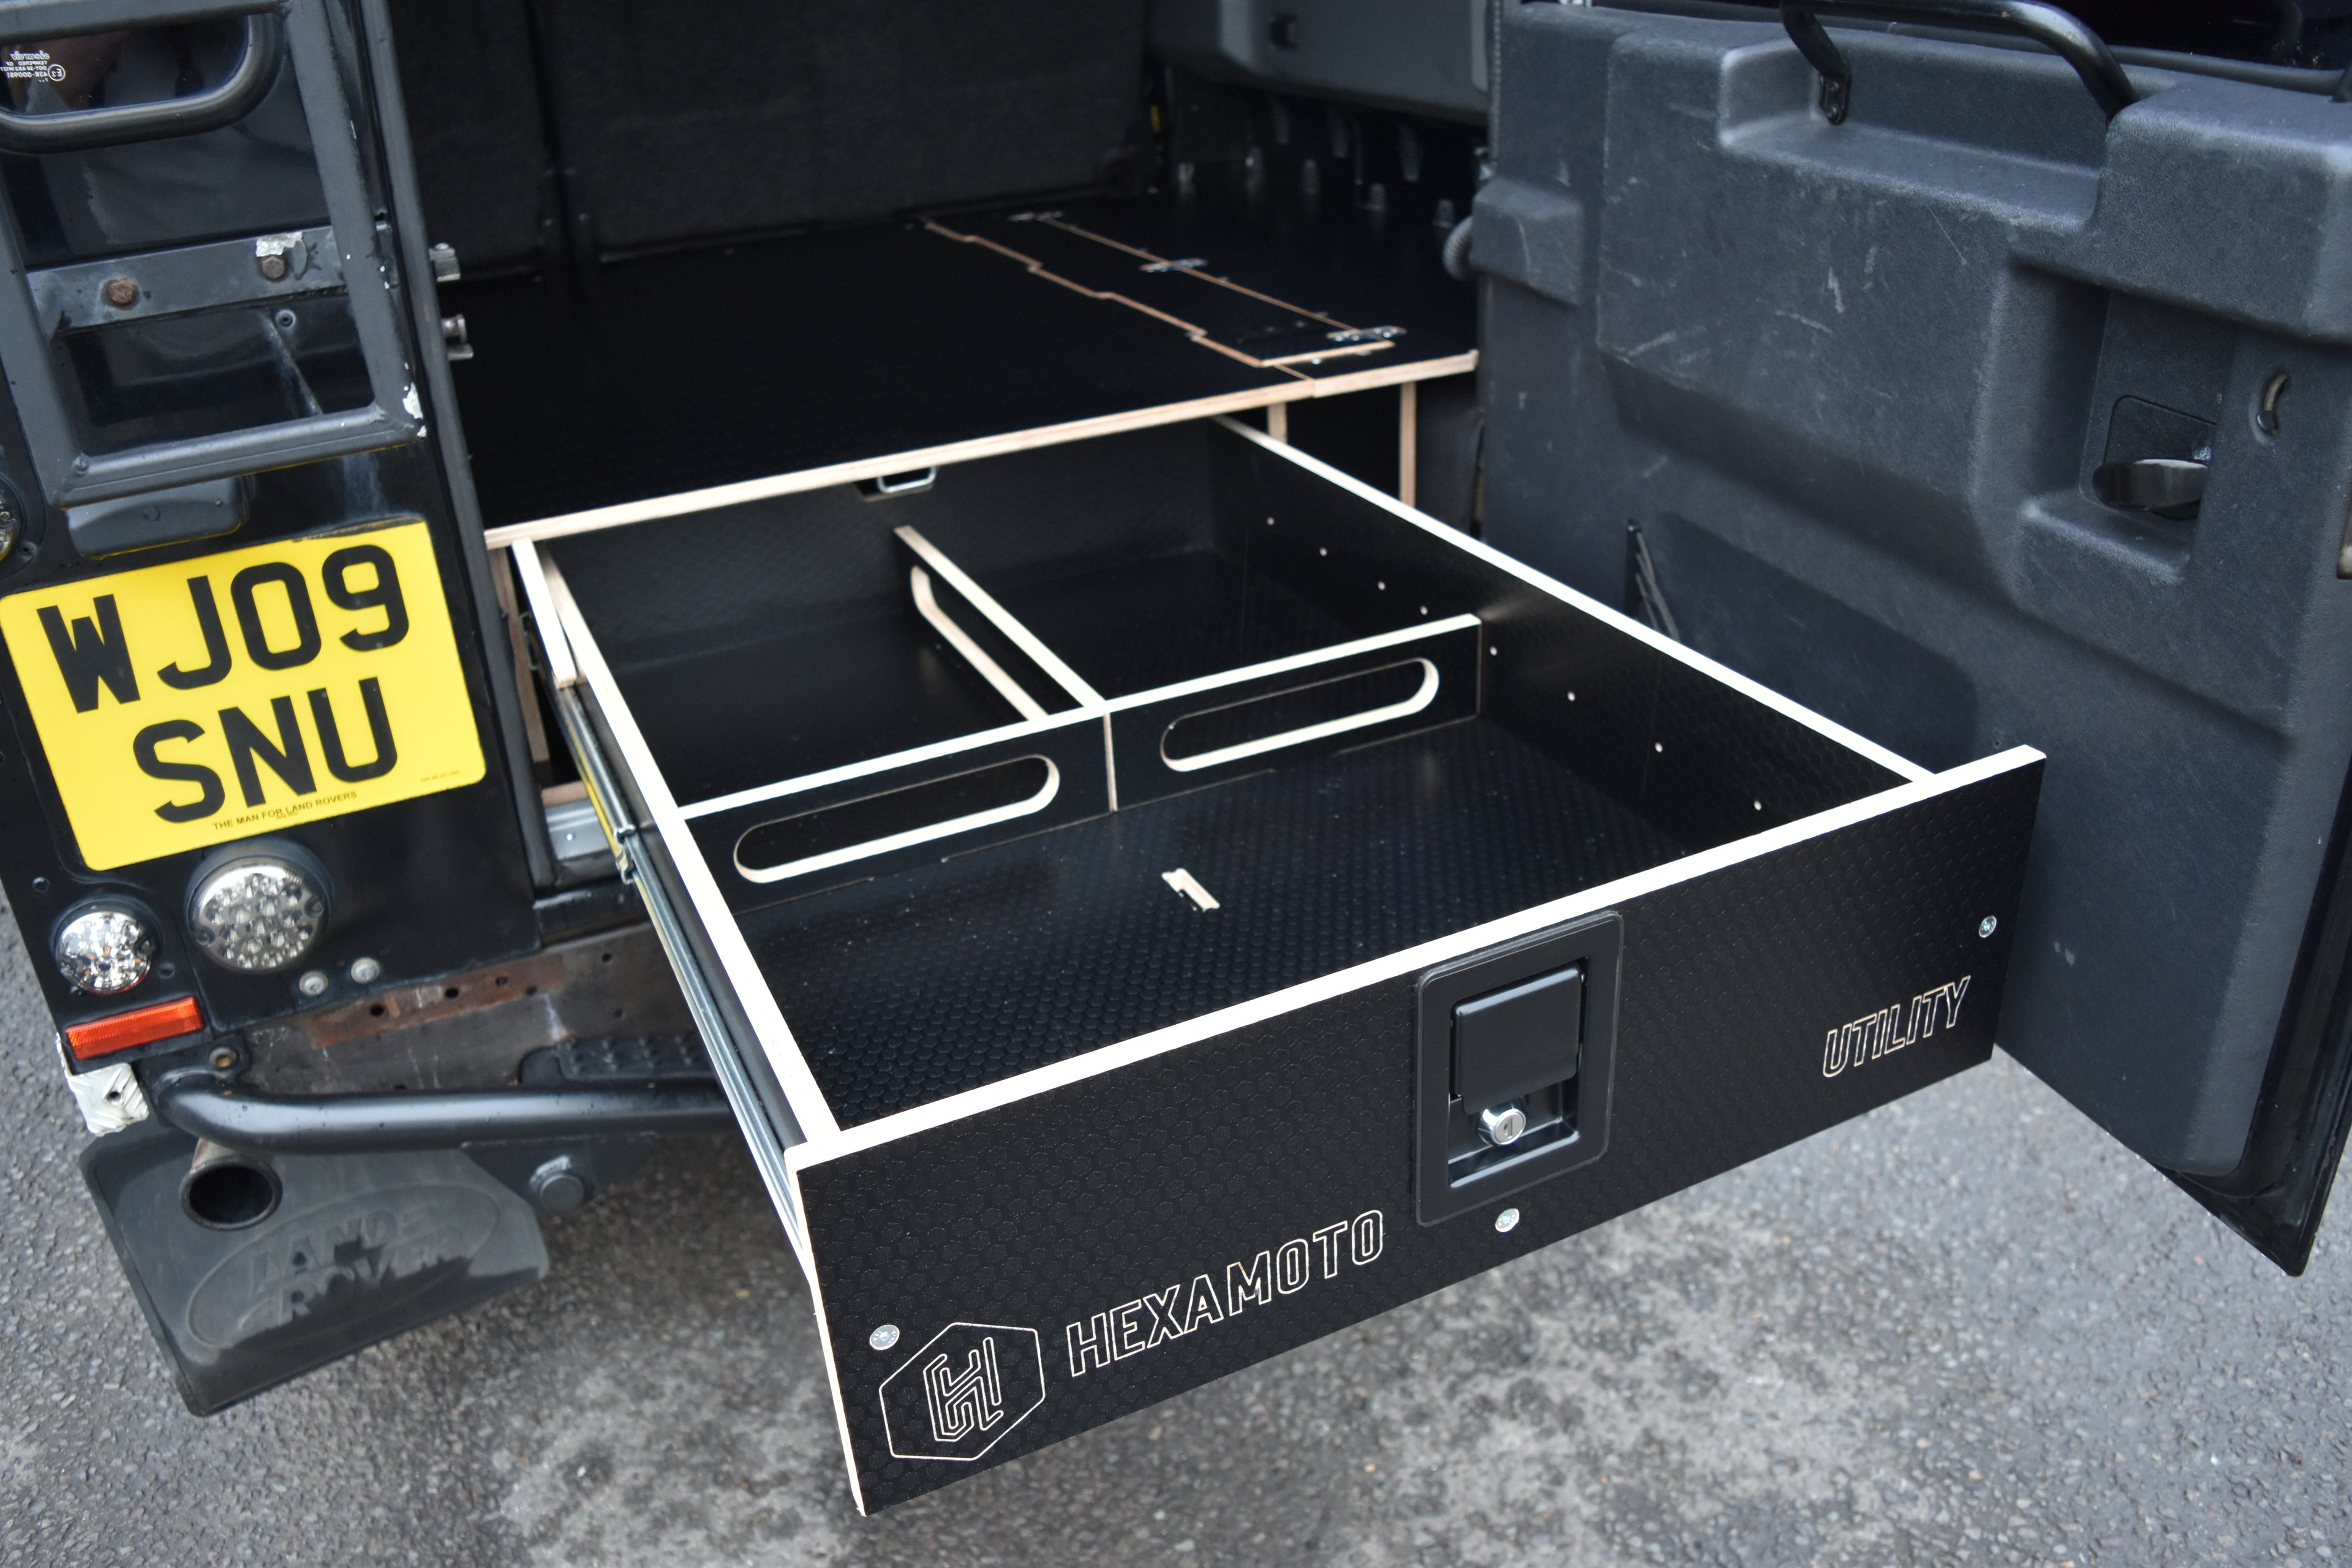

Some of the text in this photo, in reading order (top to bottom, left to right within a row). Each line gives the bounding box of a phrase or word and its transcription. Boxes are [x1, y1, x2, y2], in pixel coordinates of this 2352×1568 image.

[132, 676, 398, 824] SNU
[213, 819, 233, 831] THE
[236, 814, 259, 825] MAN
[261, 808, 284, 820] FOR
[285, 801, 313, 815] LAND
[315, 791, 358, 807] ROVERS
[1823, 974, 1971, 1078] UTILITY
[1066, 1210, 1383, 1376] HEXAMOTO
